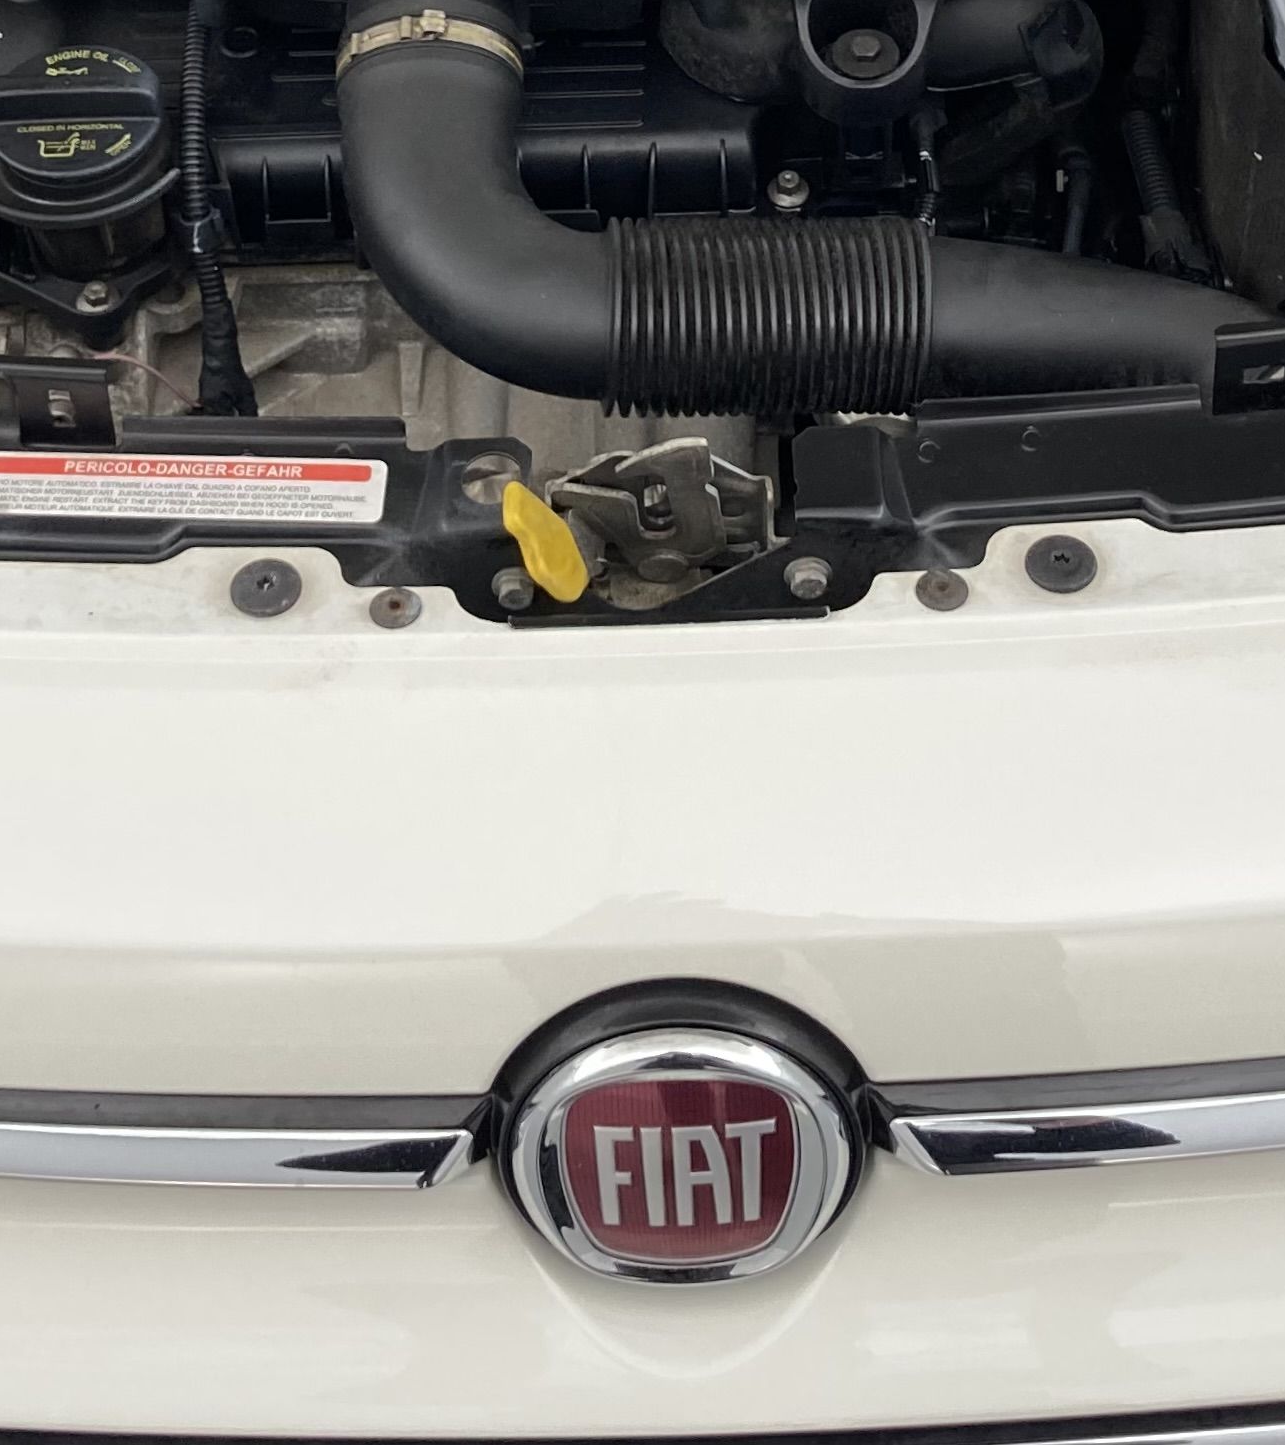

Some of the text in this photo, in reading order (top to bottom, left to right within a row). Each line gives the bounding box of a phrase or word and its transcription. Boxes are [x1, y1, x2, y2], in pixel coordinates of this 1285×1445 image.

[45, 49, 91, 65] ENGINE
[16, 123, 124, 133] CLOSED IN HORIZONTAL
[64, 459, 304, 478] PERICOLO-DANGER-GEFAHR
[188, 499, 239, 507] DASHBOARD
[197, 507, 235, 515] CONTACT
[593, 1117, 777, 1228] FIAT
